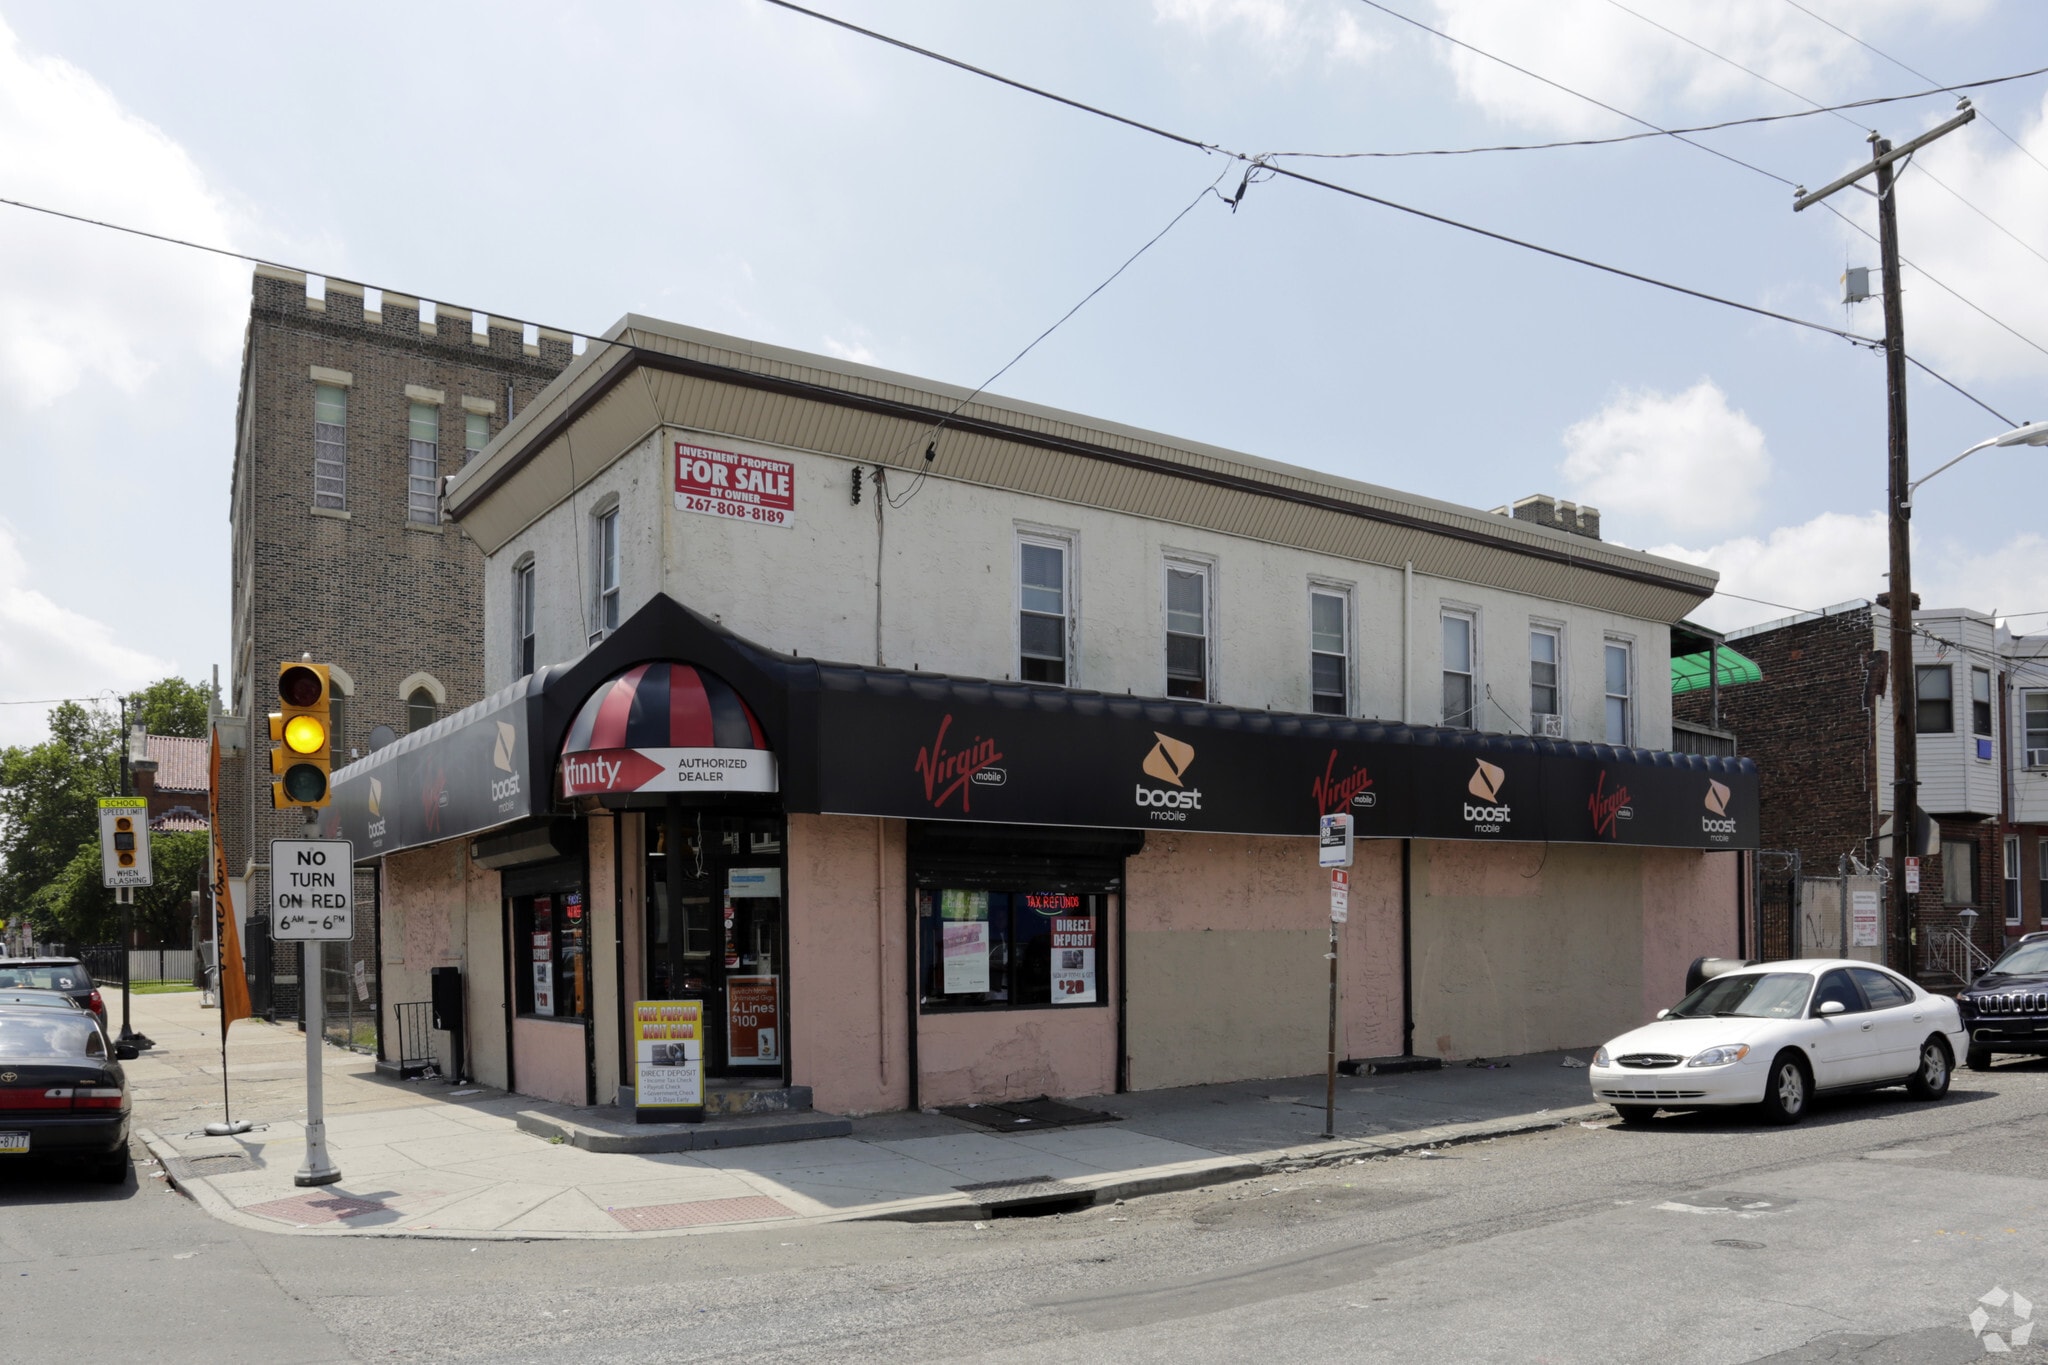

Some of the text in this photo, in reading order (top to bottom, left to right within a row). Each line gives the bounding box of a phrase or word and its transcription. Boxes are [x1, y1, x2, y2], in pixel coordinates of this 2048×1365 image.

[679, 445, 790, 474] INVESTMENT PROPERTY
[680, 457, 790, 497] FOR SALE
[710, 487, 761, 504] BY OWNER
[685, 496, 785, 524] 267-808-8189
[678, 758, 748, 769] AUTHORIZED
[915, 714, 1003, 813] Virgin
[678, 771, 724, 782] DEALER
[976, 771, 1001, 782] mobile
[1312, 749, 1373, 817] Virgin
[491, 770, 520, 801] boost
[1135, 784, 1202, 810] boost
[1354, 795, 1373, 804] mobile
[1588, 769, 1631, 839] Virgin
[103, 808, 143, 816] SPEED LIMIT
[498, 801, 514, 813] mobile
[1463, 802, 1511, 823] boost
[1150, 809, 1187, 822] mobile
[368, 816, 386, 839] boost
[1474, 824, 1500, 833] mobile
[1702, 816, 1737, 833] boost
[1321, 827, 1331, 837] 89
[1710, 834, 1730, 842] mobile
[297, 851, 326, 866] NO
[116, 869, 139, 877] WHEN
[290, 872, 335, 887] TURN
[109, 877, 147, 885] FLASHING
[279, 893, 346, 908] ON RED
[1026, 896, 1079, 909] TAX REFUNDS
[1056, 920, 1089, 932] DIRECT
[1053, 934, 1092, 946] DEPOSIT
[1059, 979, 1085, 995] $20
[638, 1006, 657, 1022] FREE
[732, 1002, 775, 1014] 4 Lines
[732, 1015, 758, 1027] $100
[643, 1023, 694, 1039] DEBIT CARD
[667, 1069, 697, 1077] DEPOSIT
